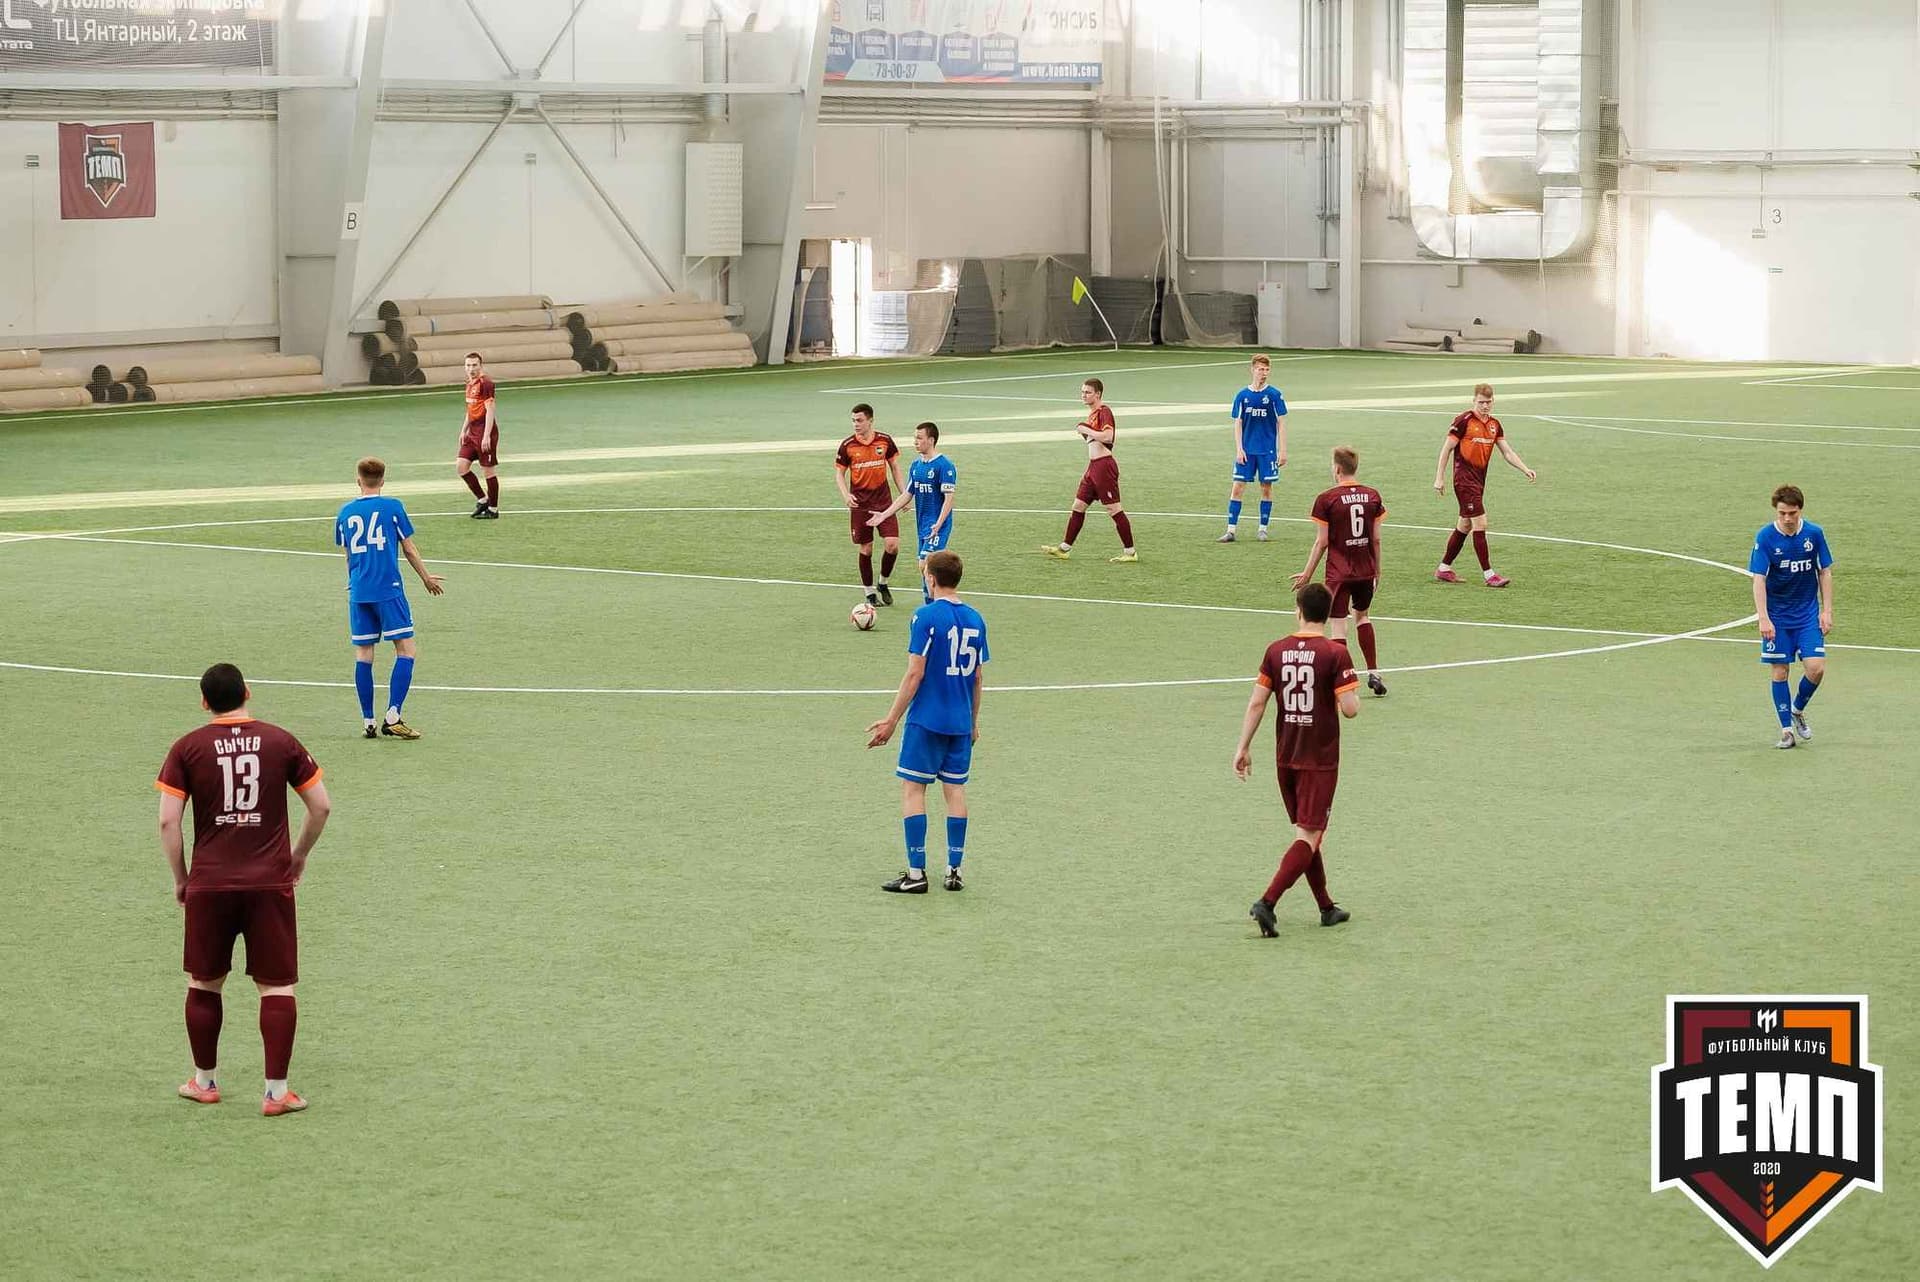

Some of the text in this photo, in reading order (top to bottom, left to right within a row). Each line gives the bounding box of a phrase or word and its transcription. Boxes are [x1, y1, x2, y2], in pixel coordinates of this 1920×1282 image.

[52, 18, 247, 46] ТЦ Янтарный, 2 этаж
[87, 155, 123, 180] ТЕМП
[347, 511, 386, 554] 24
[1350, 504, 1364, 538] 6
[1790, 560, 1812, 573] ВТБ
[945, 625, 980, 677] 15
[1281, 665, 1315, 713] 23
[1284, 713, 1313, 724] SEUS
[214, 736, 262, 755] СЫЧЕВ
[216, 754, 261, 812] 13
[215, 812, 262, 826] SEUS
